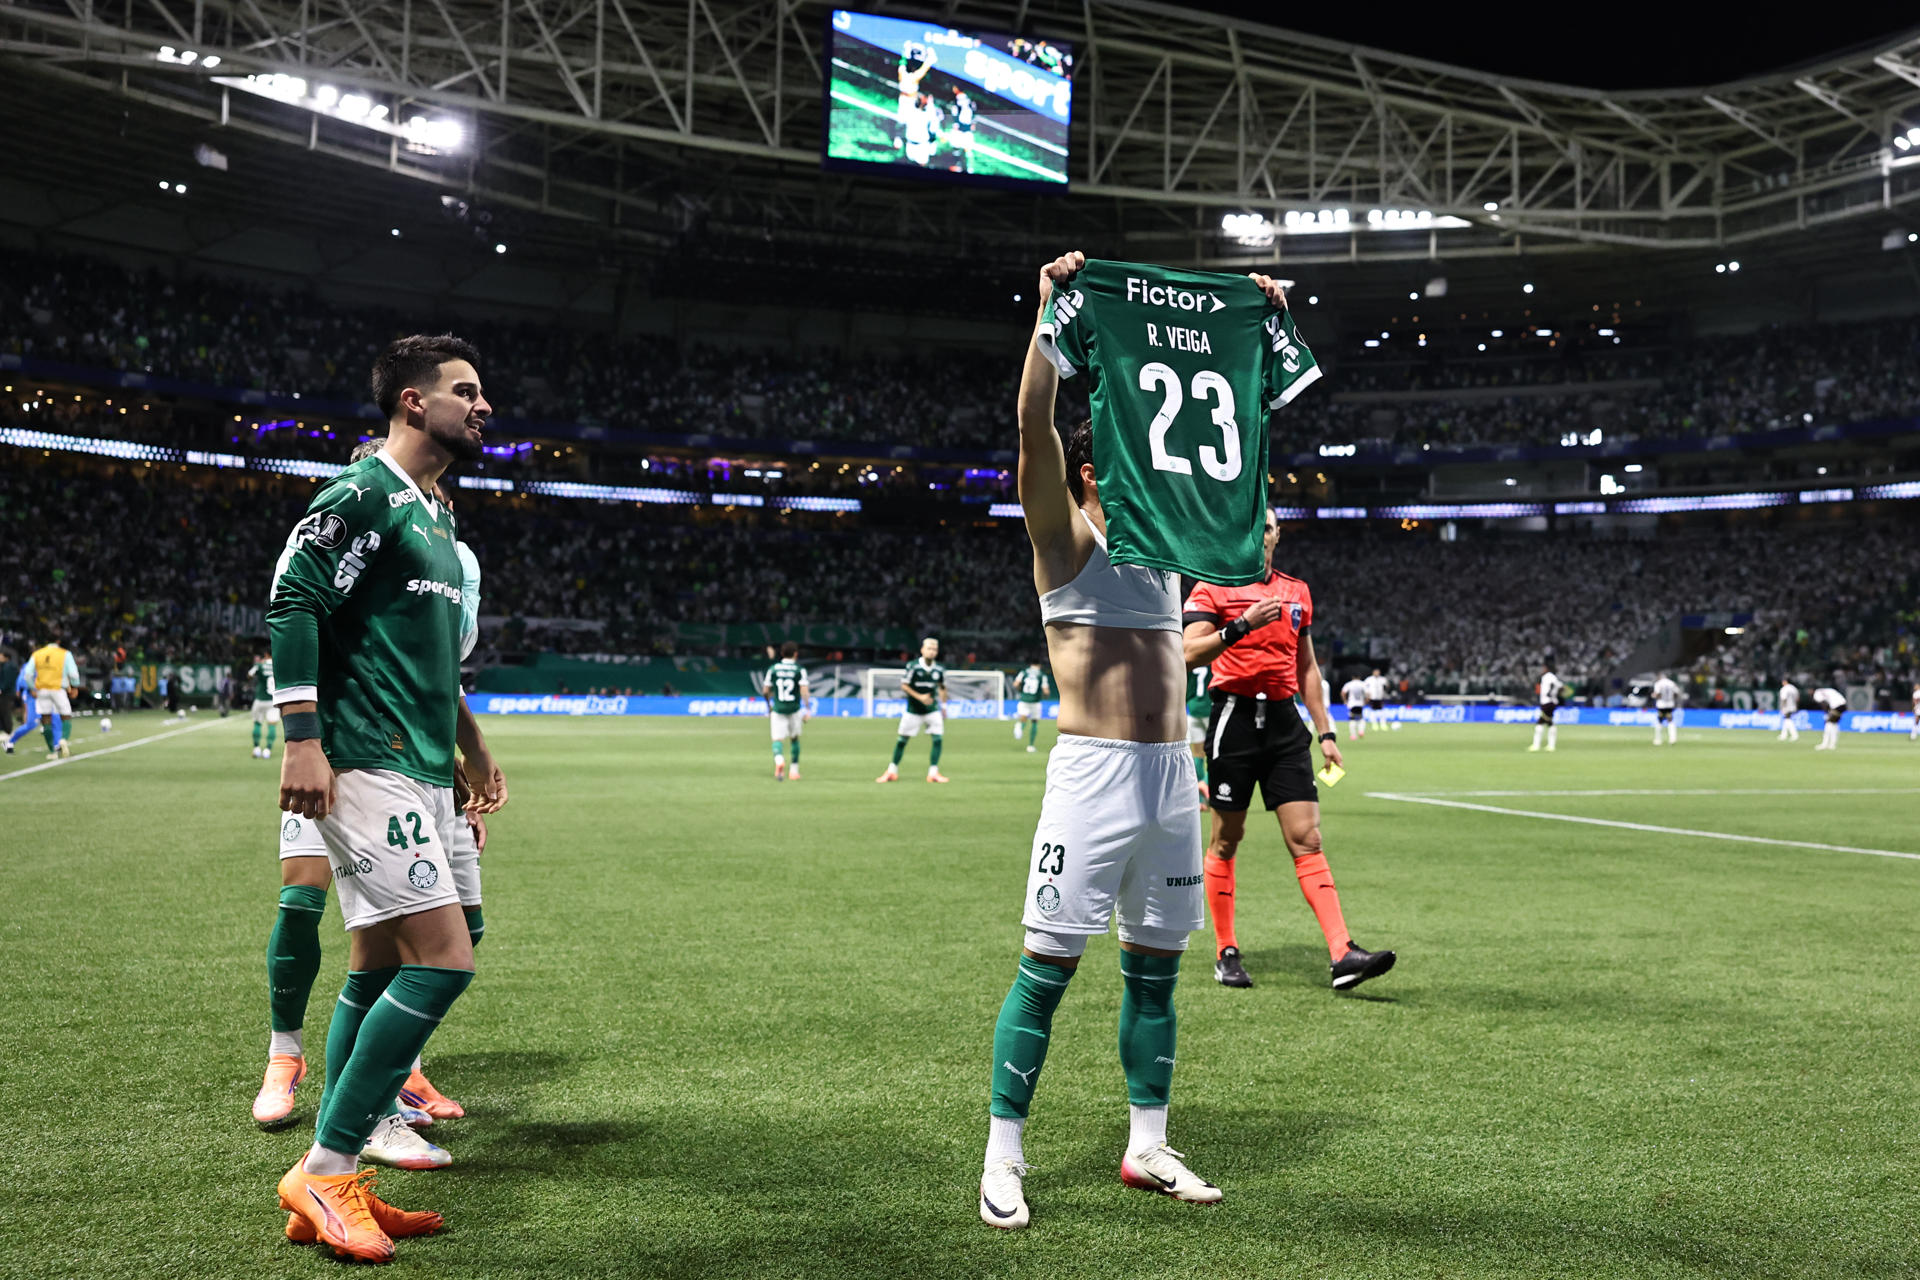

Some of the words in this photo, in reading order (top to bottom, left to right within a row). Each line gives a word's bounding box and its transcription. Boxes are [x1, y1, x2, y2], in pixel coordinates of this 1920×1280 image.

[1127, 277, 1207, 312] Fictor
[1146, 322, 1163, 347] R.
[1165, 325, 1212, 355] VEIGA
[1138, 361, 1243, 482] 23
[776, 678, 795, 702] 12
[387, 811, 430, 850] 42
[1038, 842, 1065, 876] 23
